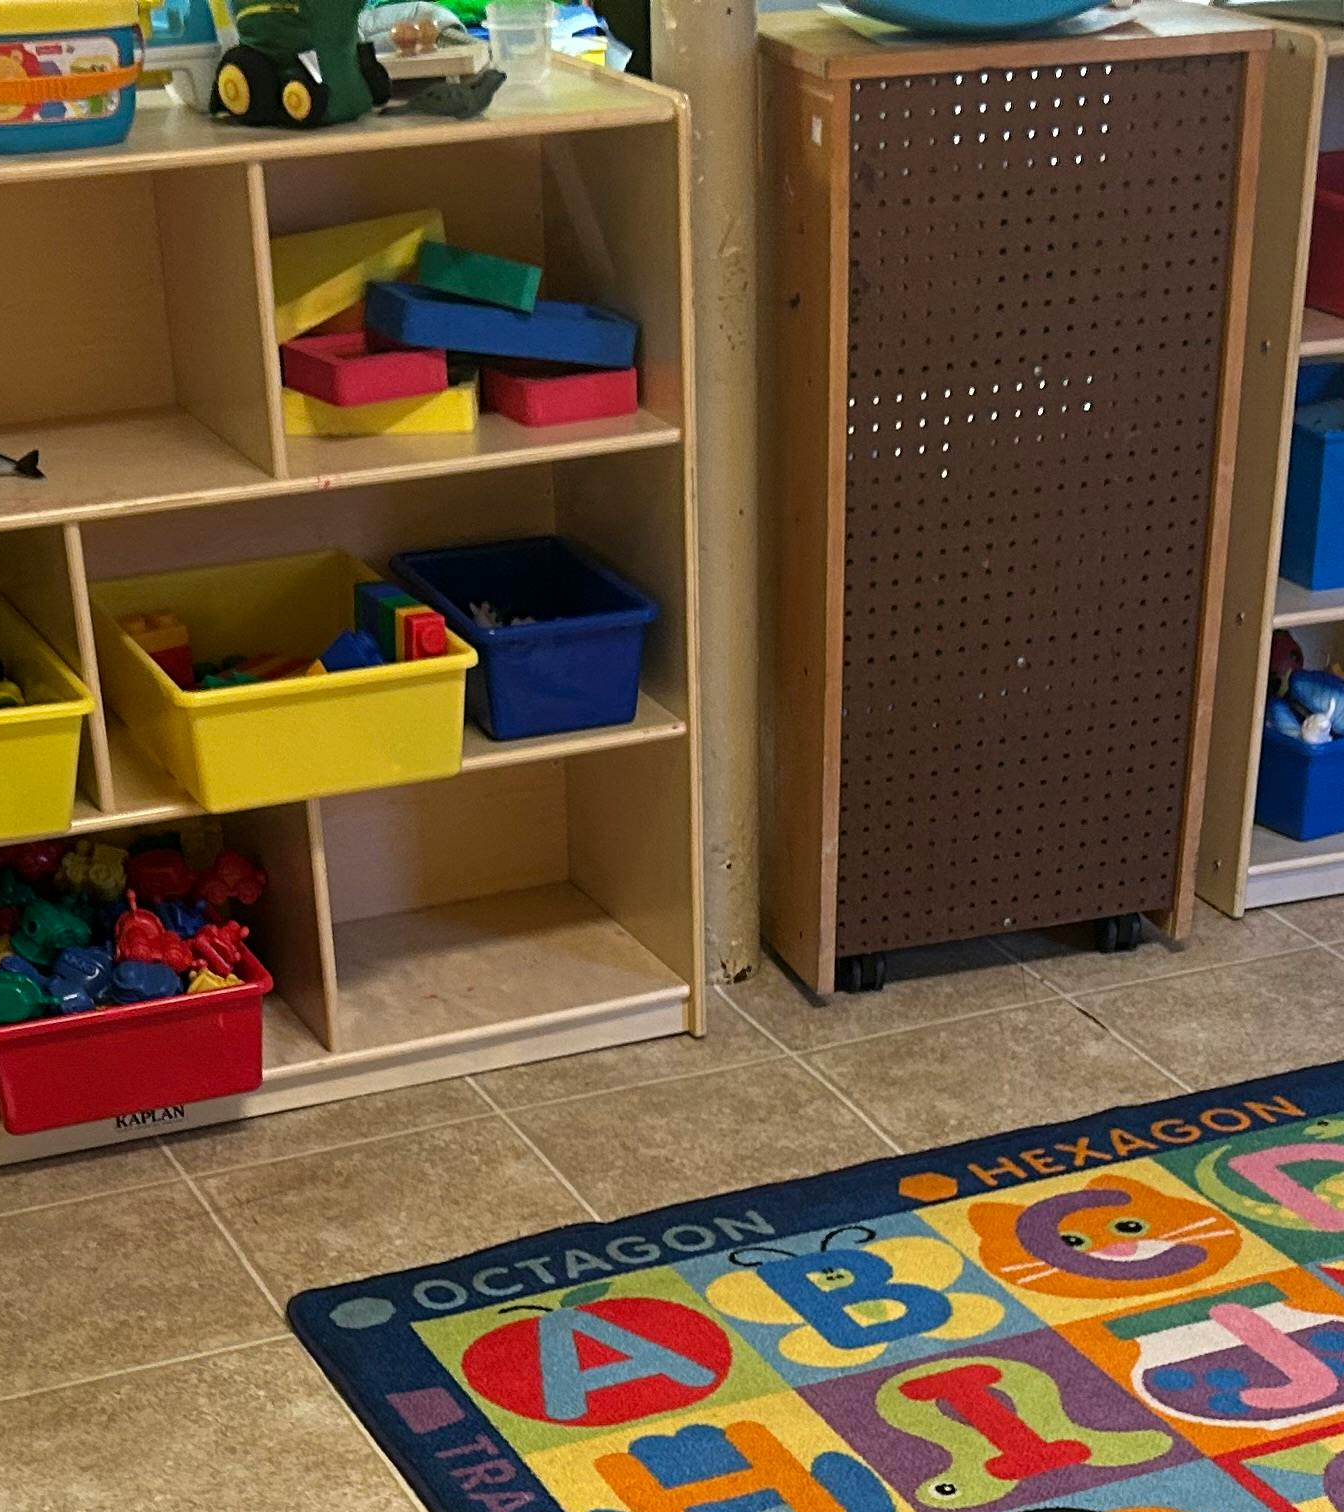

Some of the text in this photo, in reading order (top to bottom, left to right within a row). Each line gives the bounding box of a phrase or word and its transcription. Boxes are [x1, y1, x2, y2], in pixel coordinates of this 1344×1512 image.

[116, 1104, 185, 1128] KAPLAN
[967, 1095, 1306, 1187] HEXAGON
[411, 1209, 777, 1311] OCTAGON
[536, 1306, 717, 1420] A
[756, 1250, 953, 1349] B
[1014, 1188, 1208, 1281] C
[899, 1365, 1091, 1480] I
[1208, 1302, 1339, 1409] J
